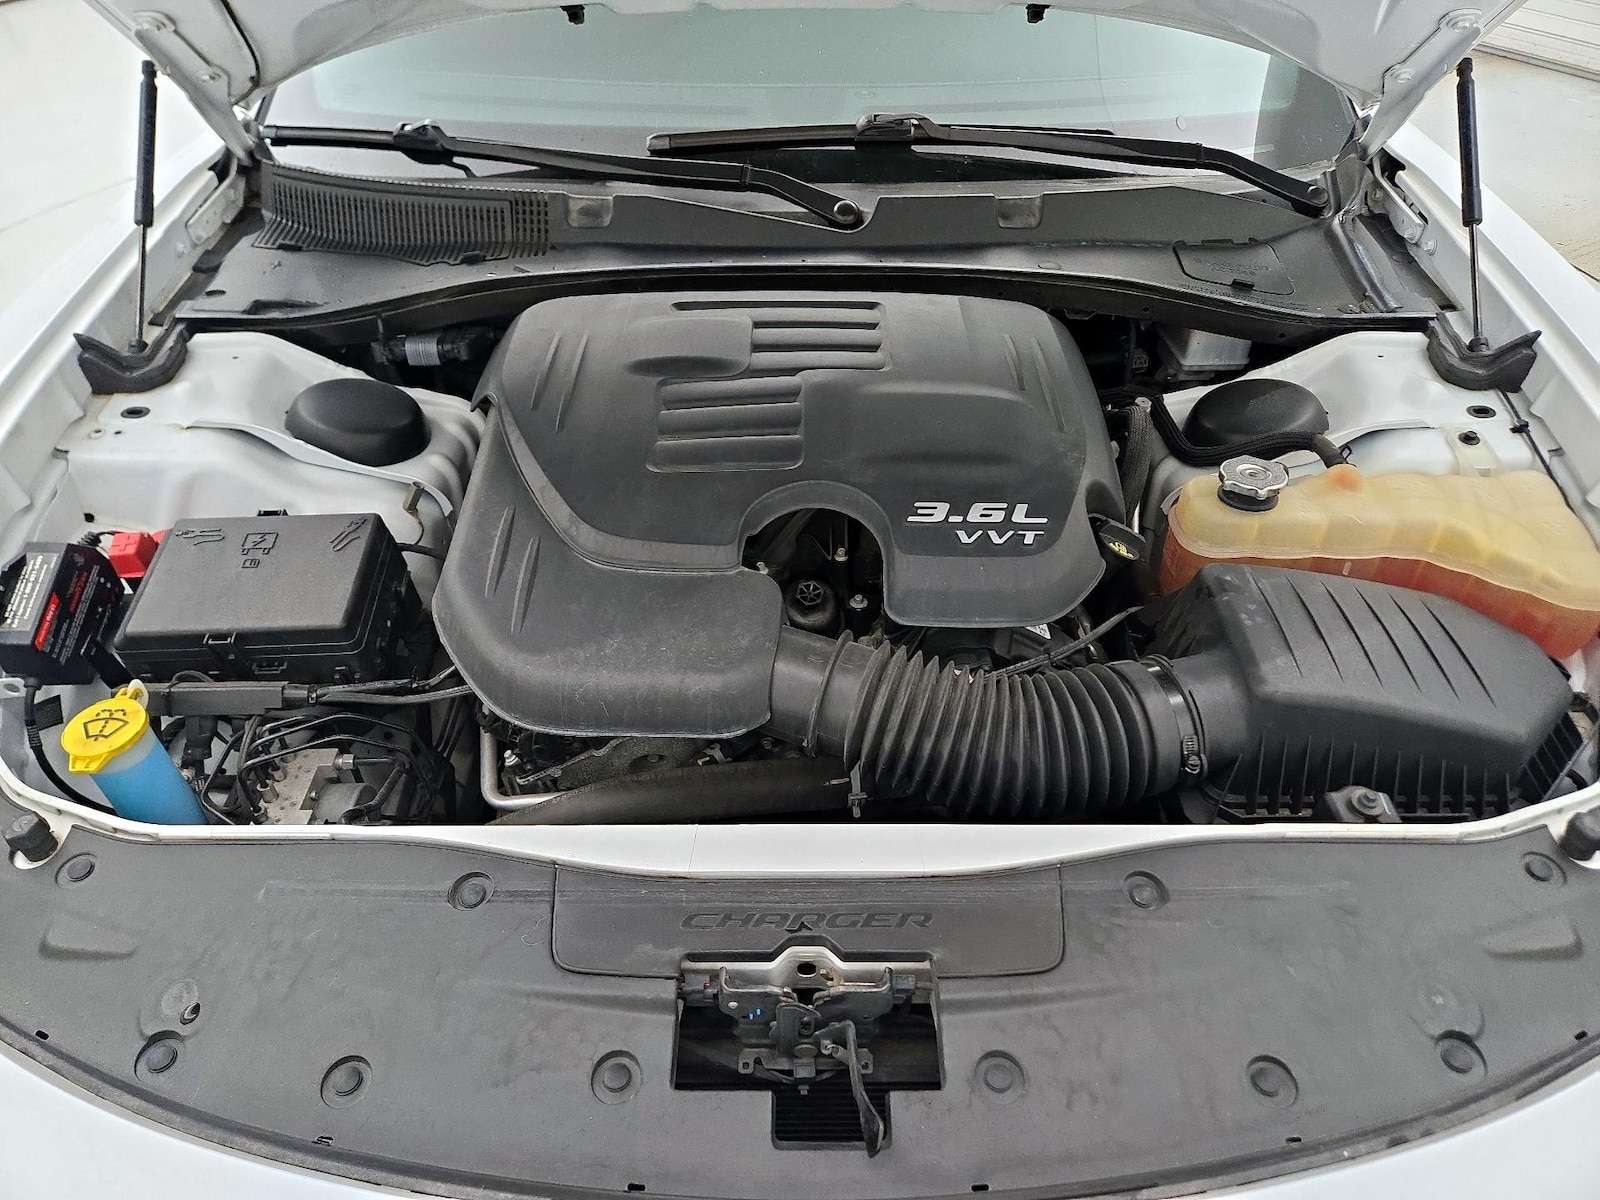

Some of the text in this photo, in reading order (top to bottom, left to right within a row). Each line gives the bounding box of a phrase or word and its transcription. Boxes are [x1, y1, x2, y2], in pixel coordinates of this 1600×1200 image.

[906, 501, 1049, 523] 3.6L
[955, 530, 1045, 544] VVT
[680, 912, 934, 930] CHARGER
